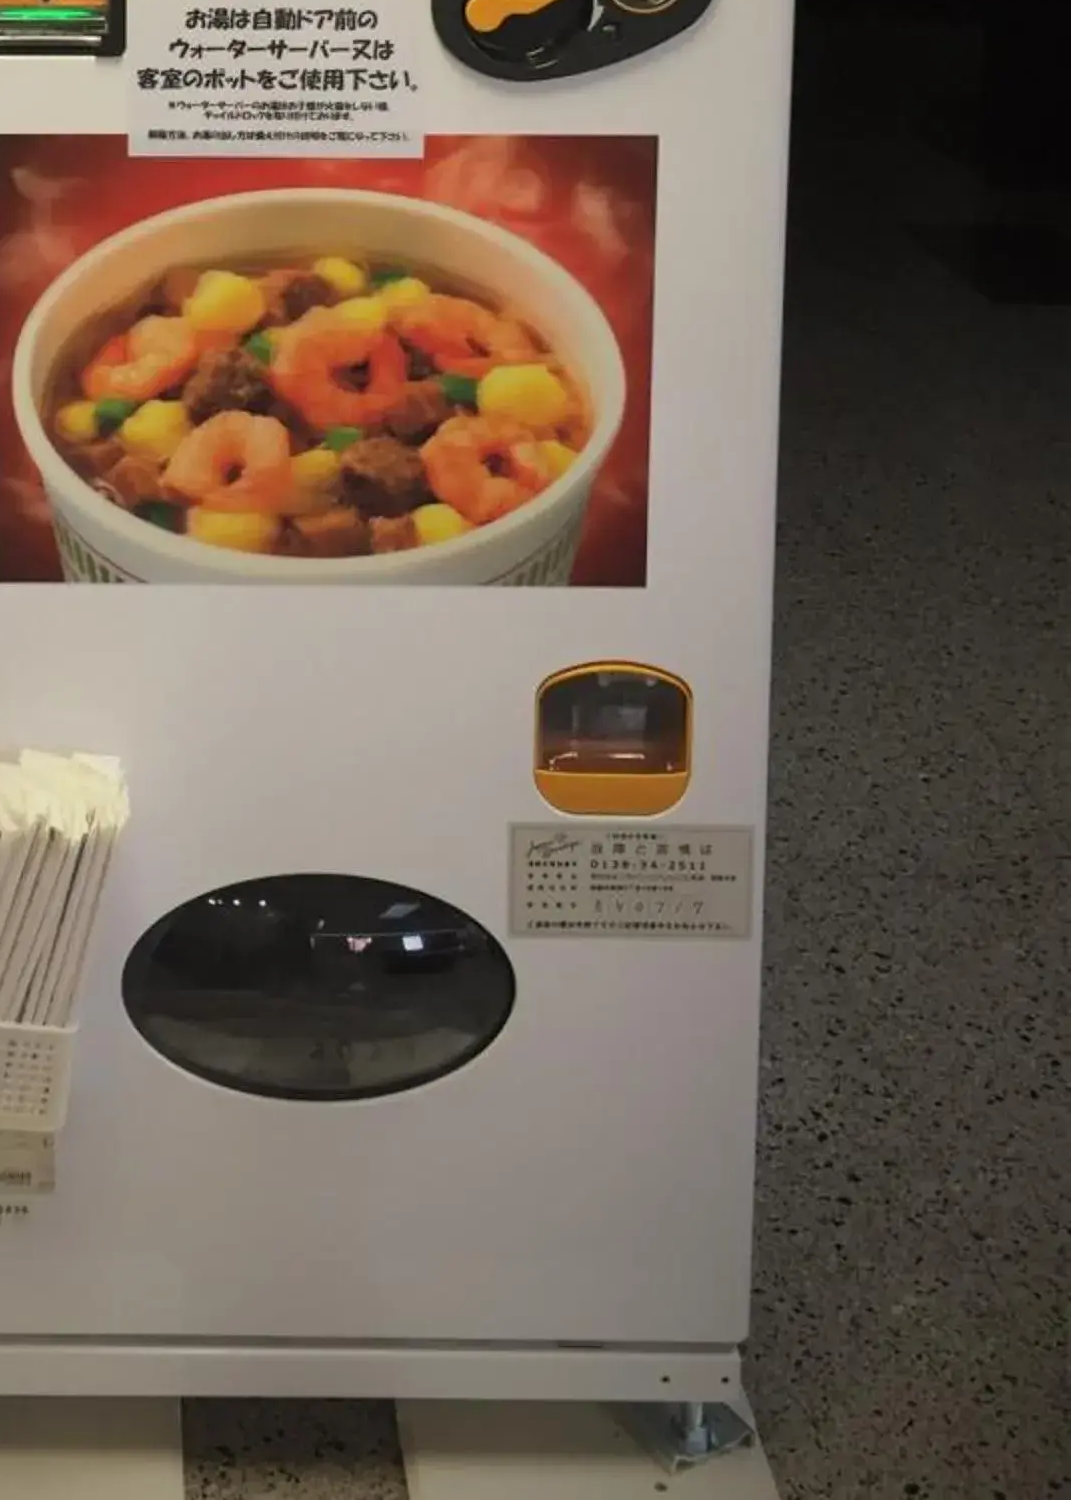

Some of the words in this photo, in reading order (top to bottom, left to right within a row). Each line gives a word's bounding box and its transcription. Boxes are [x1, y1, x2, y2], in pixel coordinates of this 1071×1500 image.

[185, 8, 378, 31] お湯は自動ドア前の
[168, 38, 395, 62] ウォーターサーバー又は
[137, 67, 419, 92] 客室のポットをご使用下さい。
